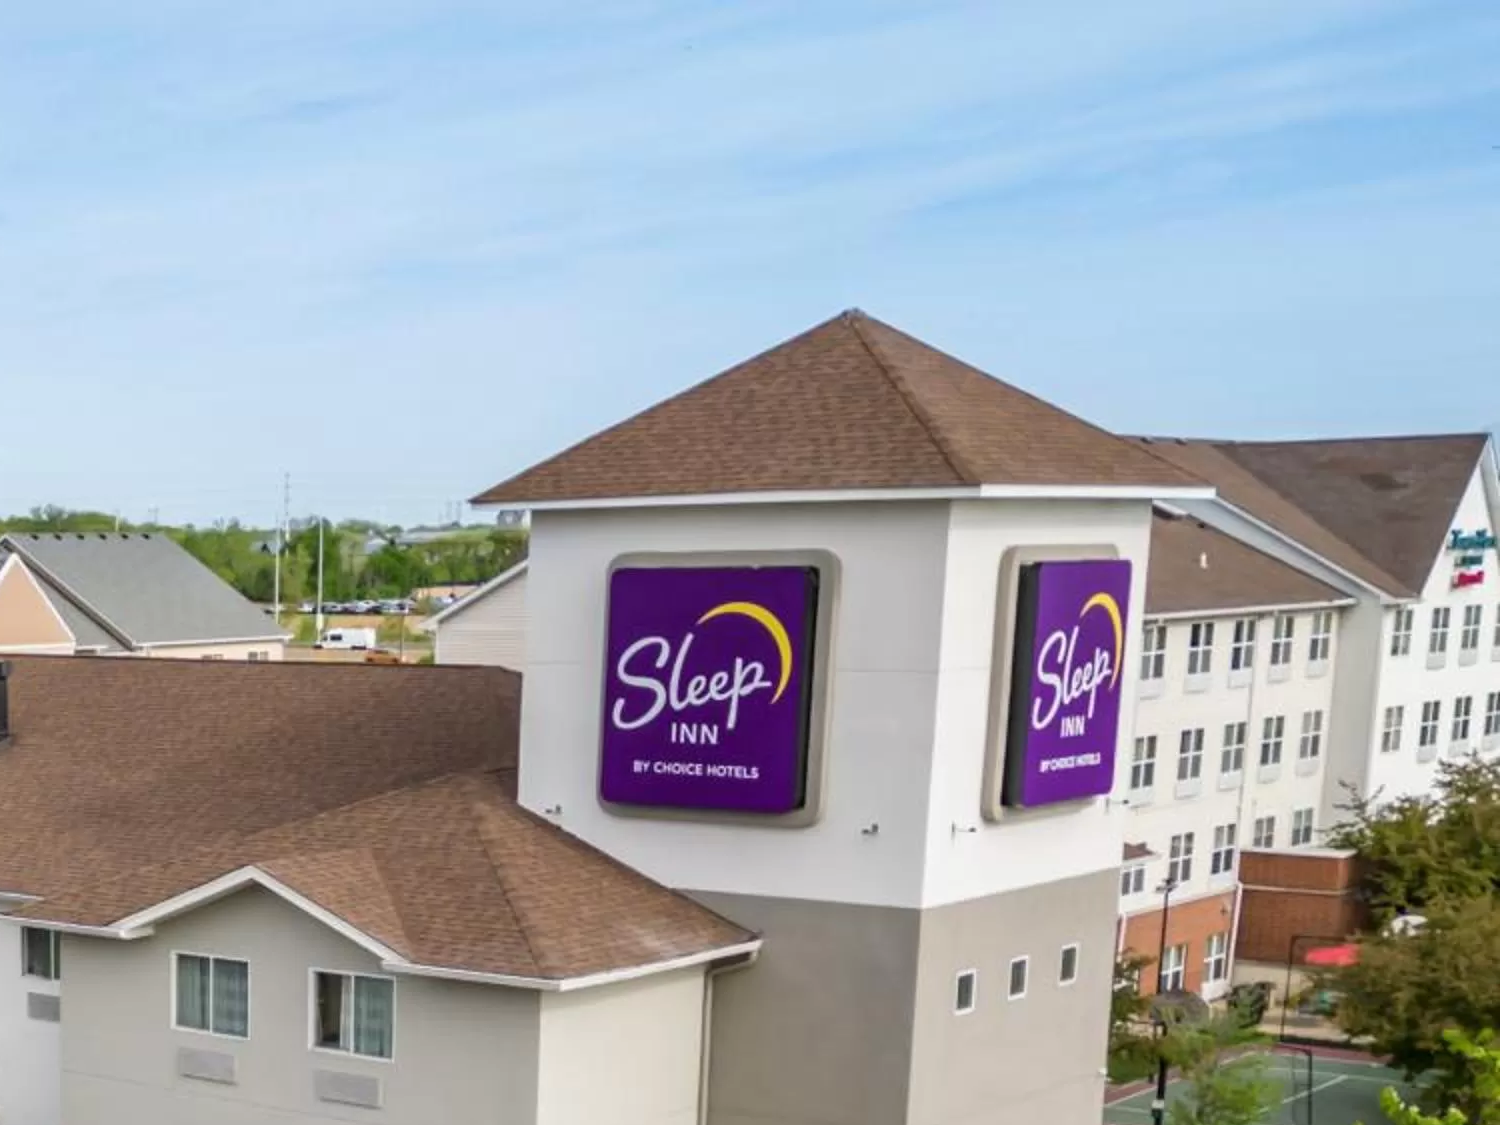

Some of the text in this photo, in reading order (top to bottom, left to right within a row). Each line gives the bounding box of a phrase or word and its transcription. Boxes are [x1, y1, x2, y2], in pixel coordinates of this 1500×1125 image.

[612, 633, 772, 729] Sleep
[1031, 625, 1112, 730] Sleep
[671, 722, 719, 745] INN
[1060, 715, 1085, 738] INN
[633, 760, 759, 779] BY CHOICE HOTELS
